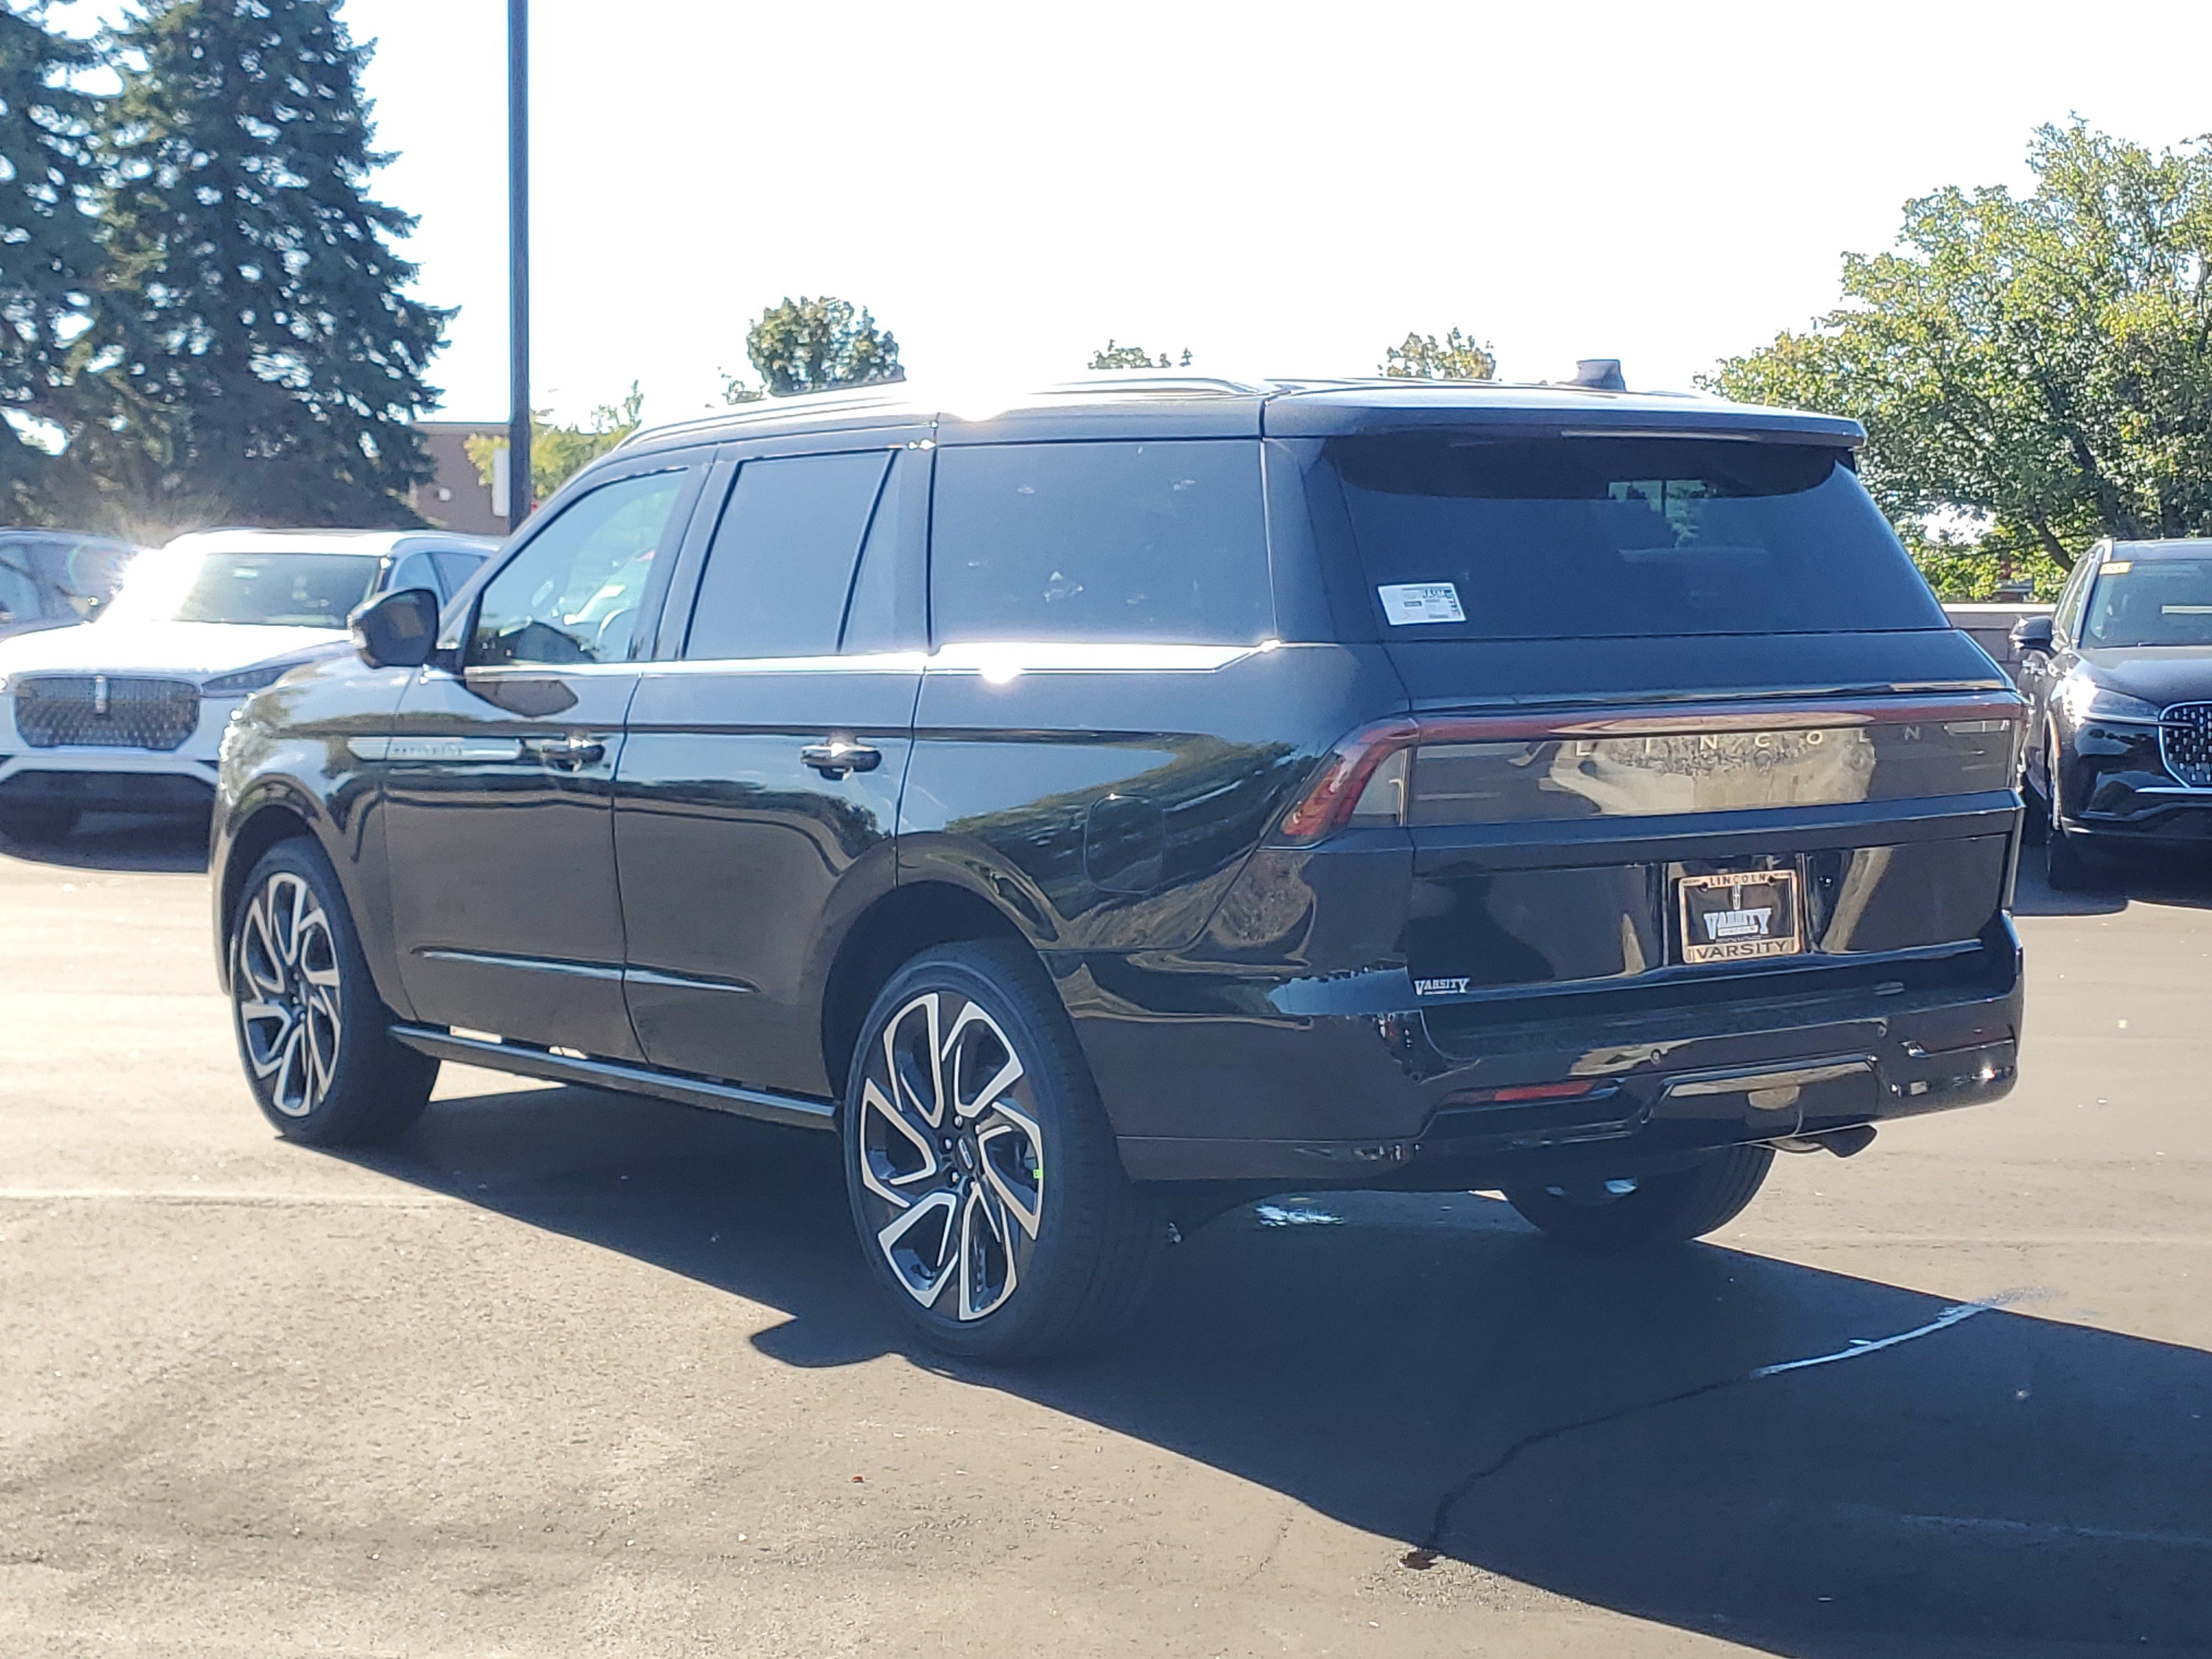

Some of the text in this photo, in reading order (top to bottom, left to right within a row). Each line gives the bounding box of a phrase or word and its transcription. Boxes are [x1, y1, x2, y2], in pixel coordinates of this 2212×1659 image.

[1576, 726, 1920, 757] LINCOLN
[1709, 873, 1766, 886] LINCOLN
[1696, 941, 1786, 959] VARSITY
[1414, 978, 1470, 996] VARSITY
